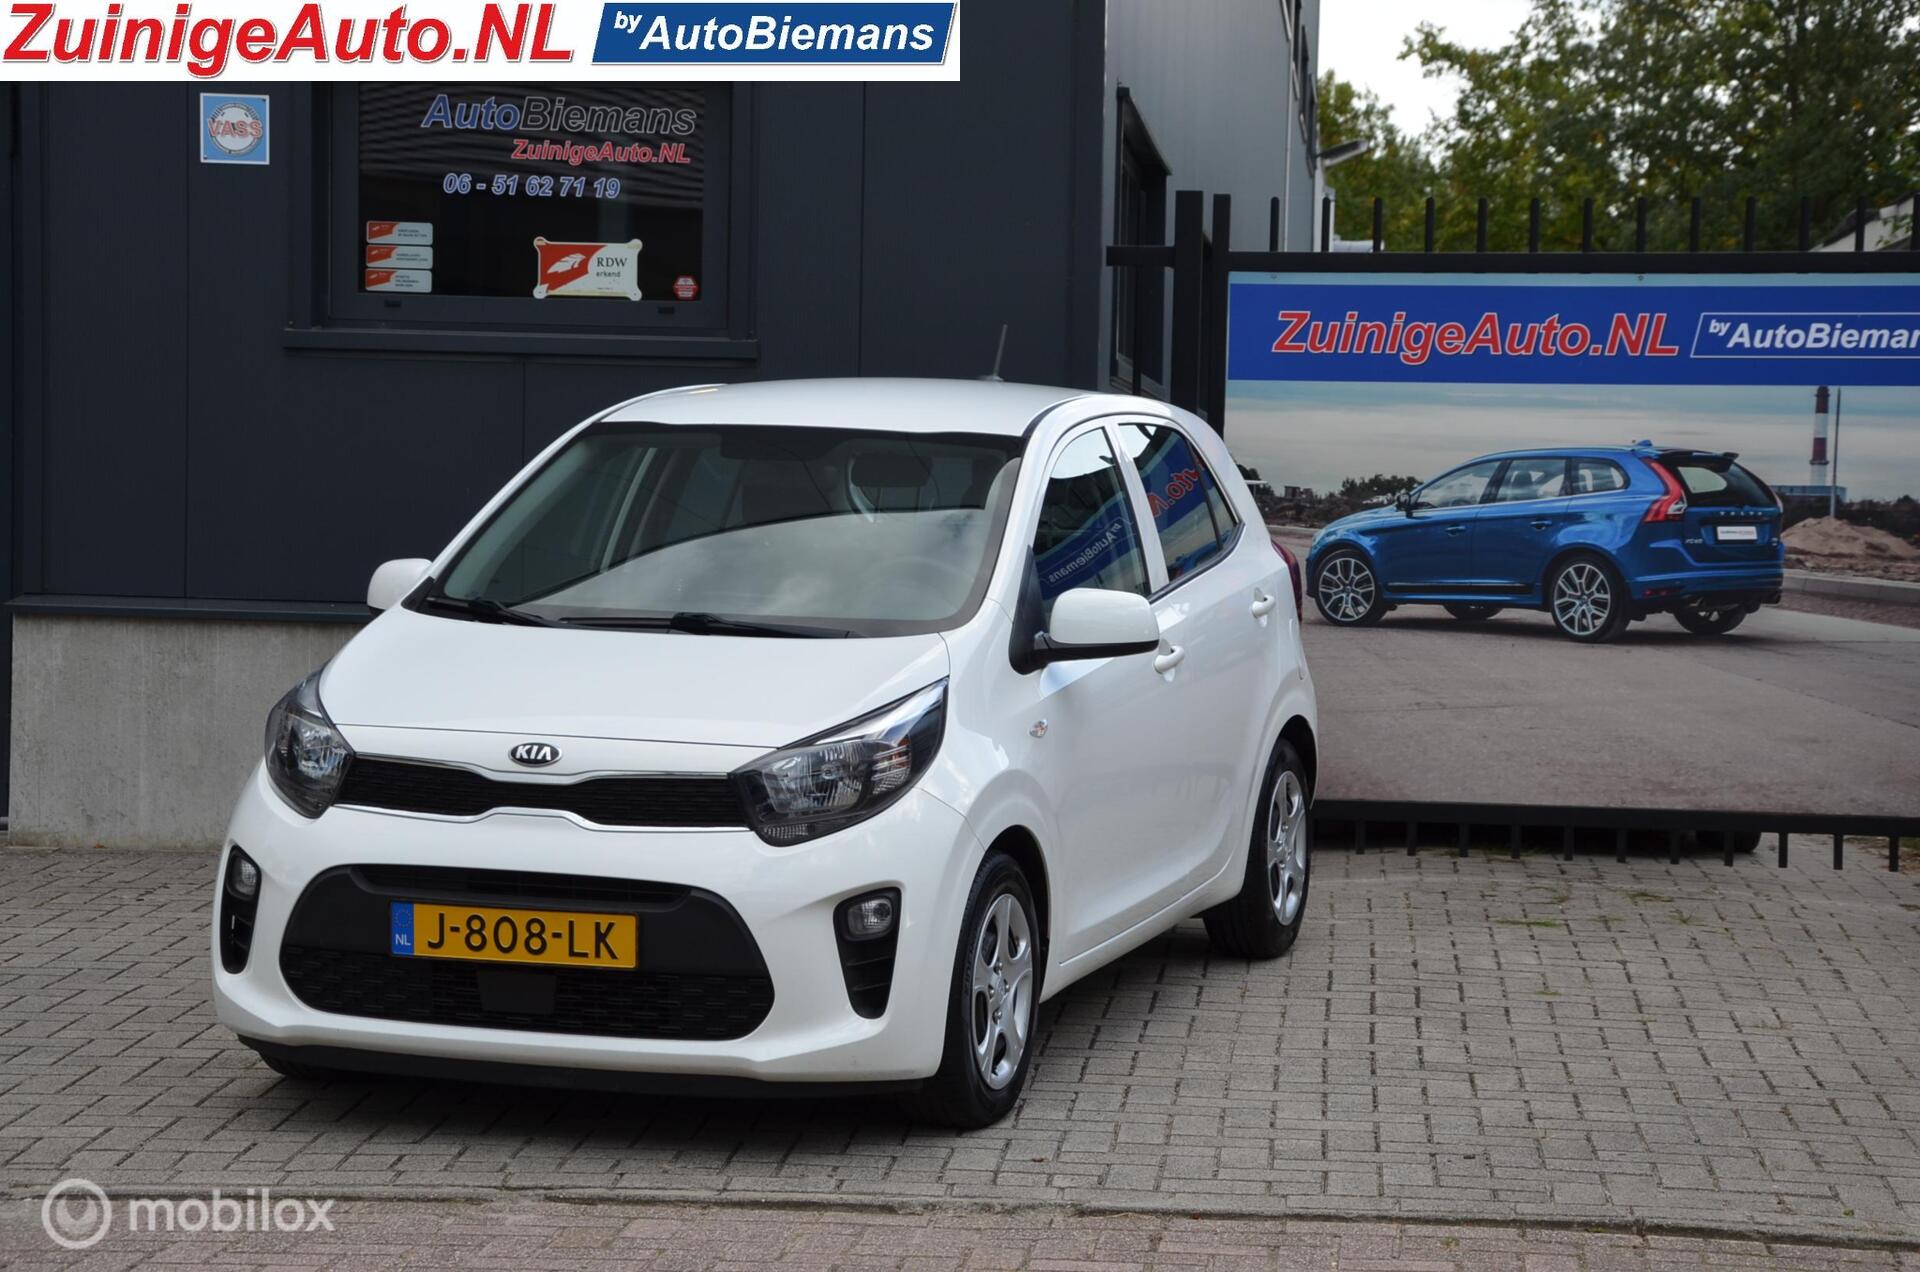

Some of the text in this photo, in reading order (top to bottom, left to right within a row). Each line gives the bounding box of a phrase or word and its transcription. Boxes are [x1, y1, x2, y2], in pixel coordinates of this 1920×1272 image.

[421, 94, 697, 135] AutoBiemans
[208, 118, 262, 138] VASS
[511, 139, 691, 166] ZuinigeAuto.NL
[443, 172, 472, 194] 06
[491, 174, 519, 195] 51
[525, 175, 553, 196] 62
[559, 177, 586, 197] 71
[593, 178, 621, 198] 19
[596, 257, 628, 268] RDW
[596, 270, 621, 278] erkend
[1271, 310, 1680, 366] ZuinigeAuto.NL
[1708, 319, 1731, 336] by
[515, 745, 551, 760] KIA
[395, 934, 411, 946] NL
[427, 912, 618, 960] J-808-LK
